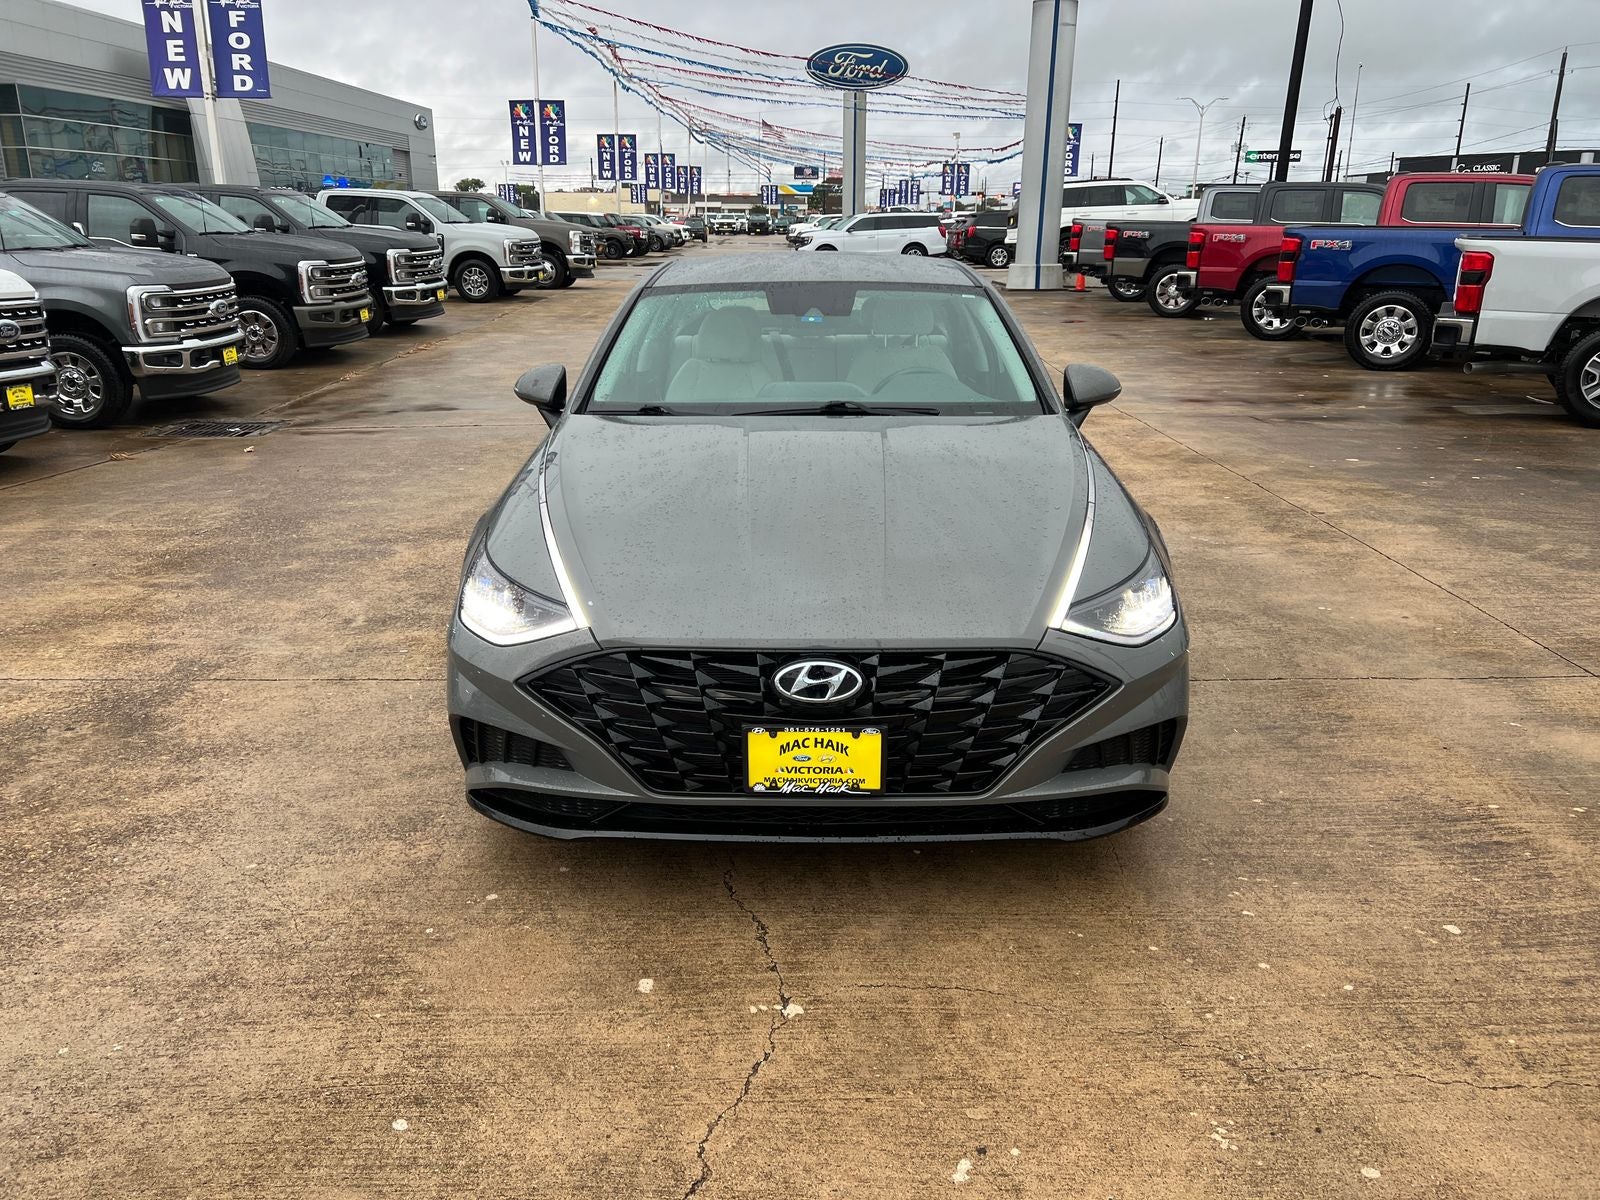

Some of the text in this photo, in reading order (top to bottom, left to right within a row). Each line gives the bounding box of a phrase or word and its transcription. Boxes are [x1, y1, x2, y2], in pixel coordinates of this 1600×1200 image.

[160, 10, 192, 90] NEW
[227, 10, 254, 91] FORD
[828, 51, 888, 79] Ford
[518, 126, 531, 162] NEW
[548, 126, 560, 163] FORD
[602, 152, 612, 179] NEW
[623, 152, 632, 179] FORD
[1064, 144, 1073, 175] FORD
[1248, 153, 1301, 161] enterse
[648, 167, 656, 188] NEW
[664, 167, 672, 188] FORD
[944, 176, 952, 195] NEW
[1212, 233, 1246, 242] FX4
[1309, 239, 1352, 250] FX4
[779, 737, 849, 757] MAC HAIK
[785, 766, 844, 775] VICTORIA
[780, 780, 851, 794] Mac Haik
